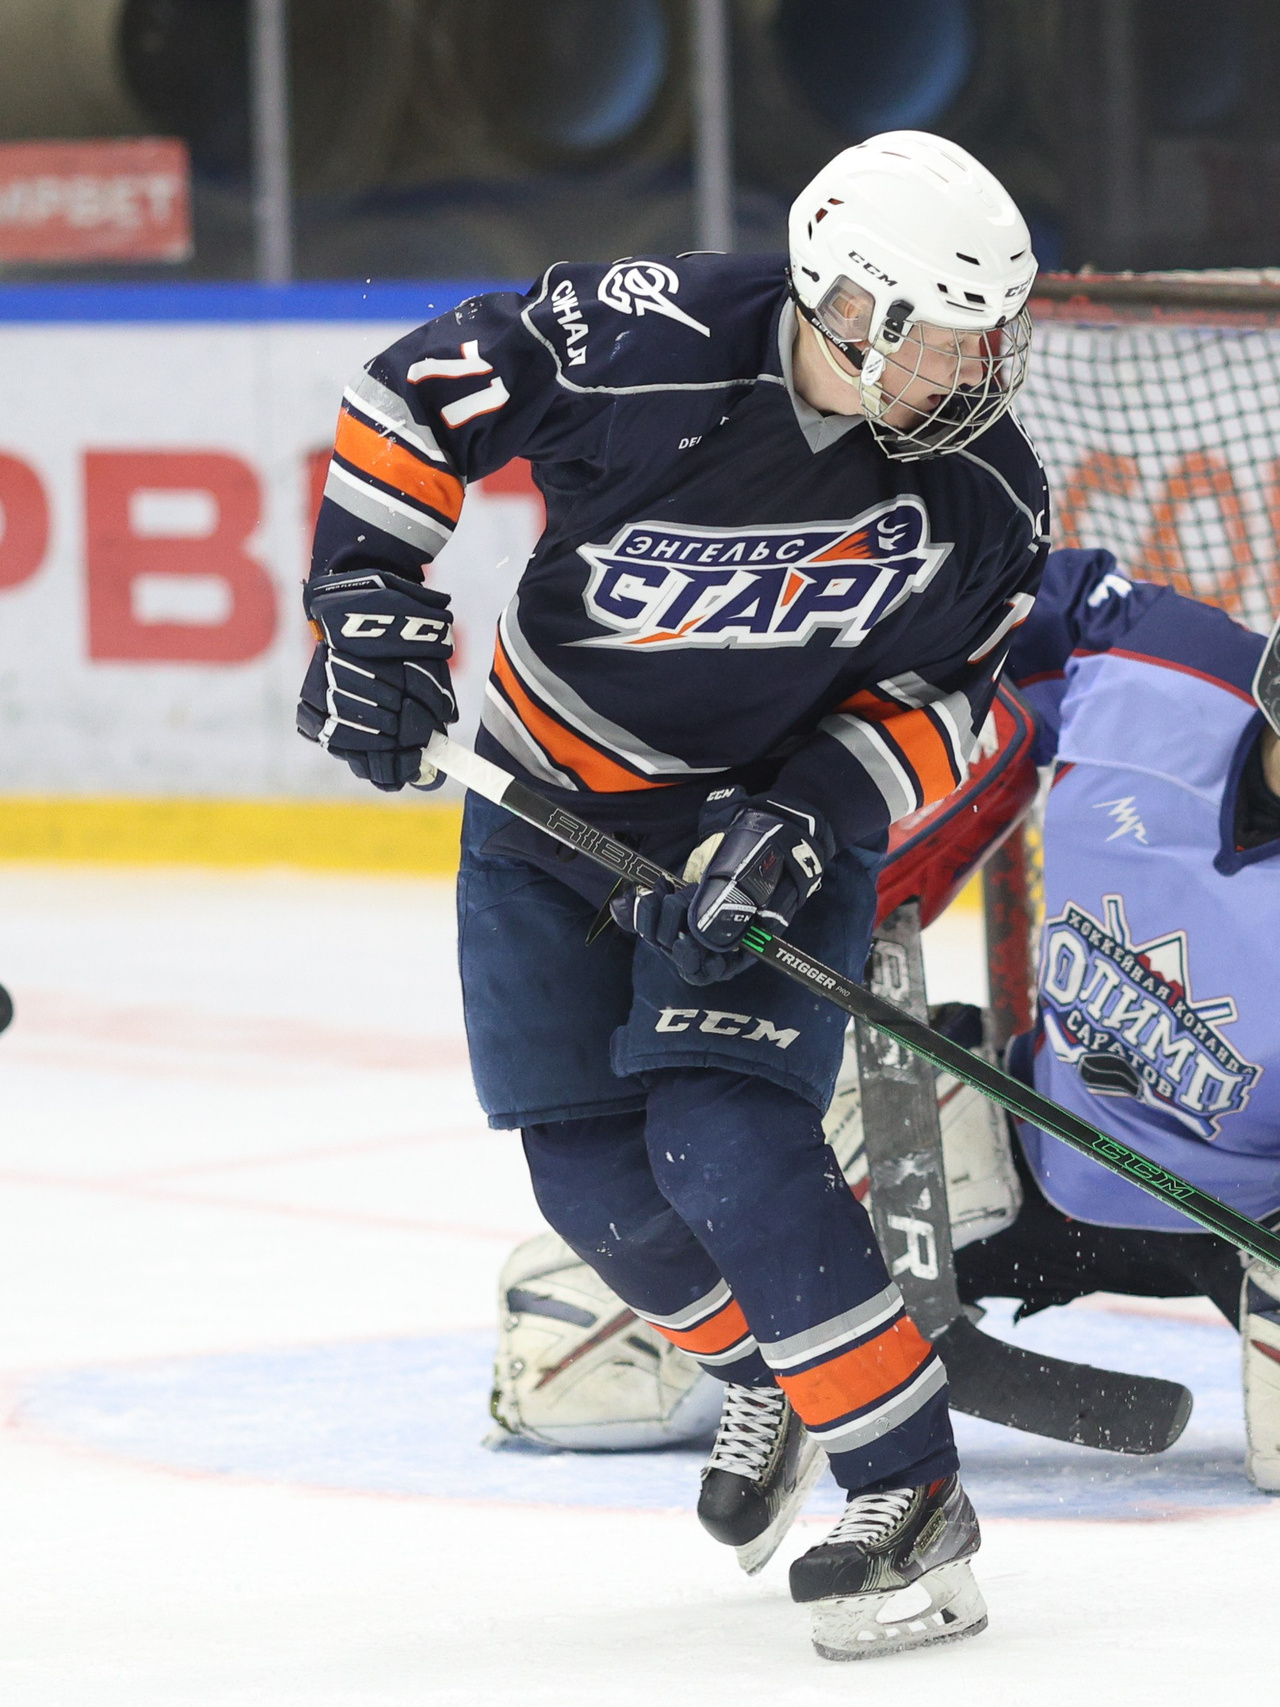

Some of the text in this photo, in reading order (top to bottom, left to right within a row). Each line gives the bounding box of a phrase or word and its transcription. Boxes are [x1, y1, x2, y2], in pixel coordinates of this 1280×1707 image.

[848, 250, 898, 287] CCM
[406, 339, 511, 429] 71
[626, 536, 805, 564] ЭНГЕЛЬС
[706, 787, 735, 802] CCM
[546, 807, 691, 891] RIBC
[775, 947, 851, 998] TRIGGER PRO
[1068, 910, 1173, 1002] ХОККЕЙНАЯ
[654, 1008, 801, 1050] CCM
[1044, 930, 1245, 1112] ОЛИМП
[1065, 1009, 1176, 1099] САРАТОВ
[1092, 1133, 1197, 1201] CCM
